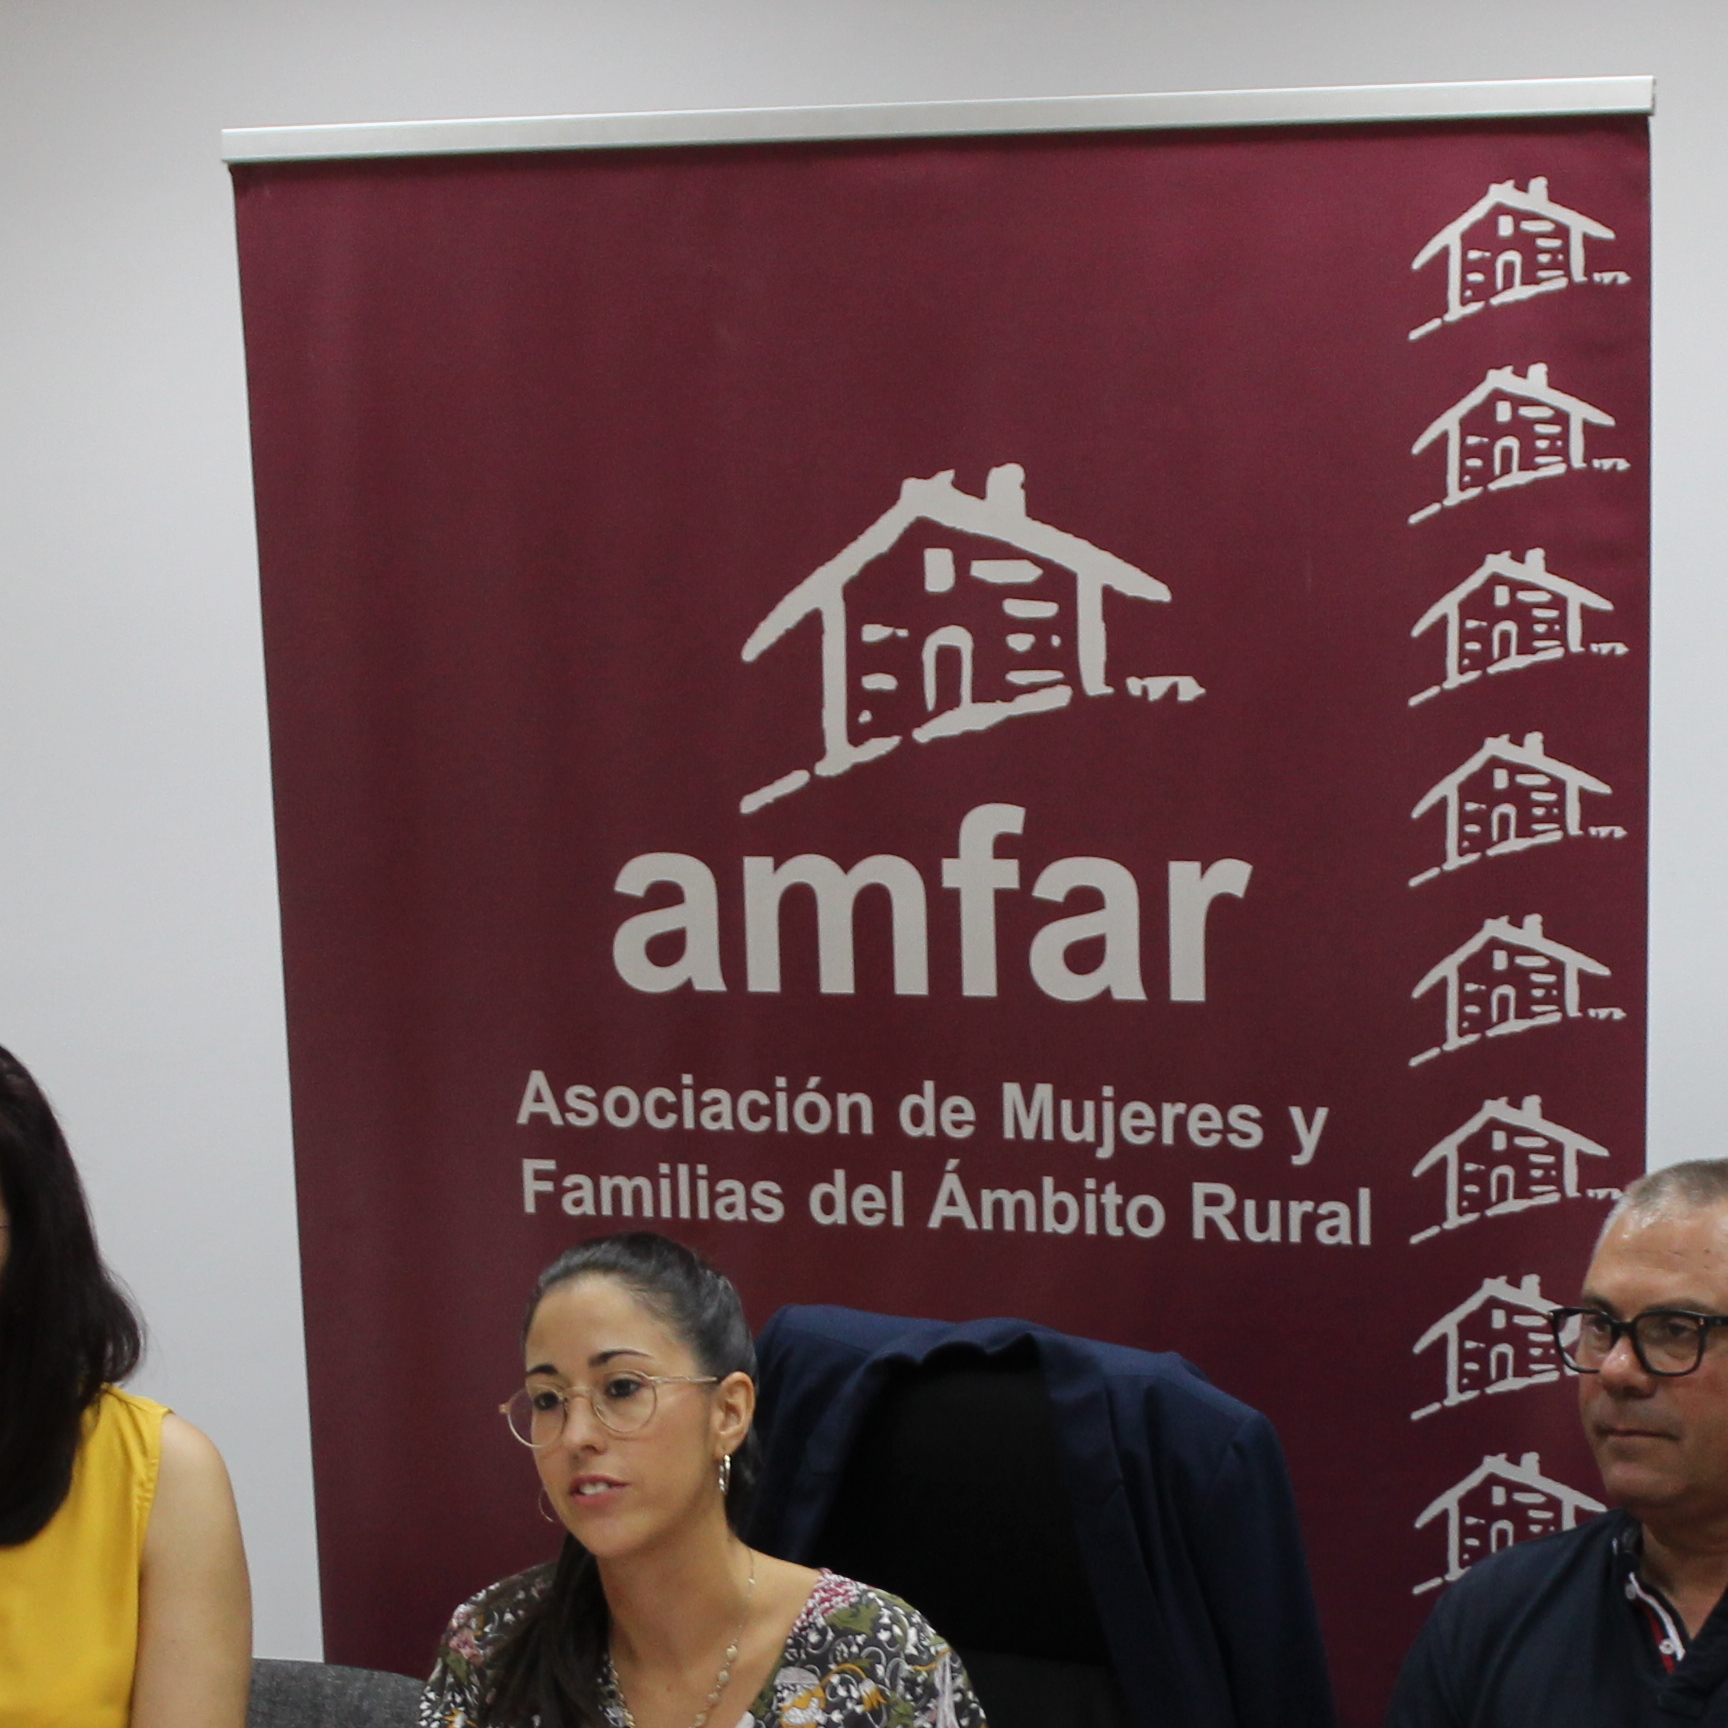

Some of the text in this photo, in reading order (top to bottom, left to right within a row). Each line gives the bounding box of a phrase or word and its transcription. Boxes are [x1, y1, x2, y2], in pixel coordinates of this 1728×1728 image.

[613, 803, 1253, 1002] amfar
[517, 1070, 1328, 1165] Asociación de Mujeres y
[522, 1159, 1371, 1245] Familias del Ámbito Rural
